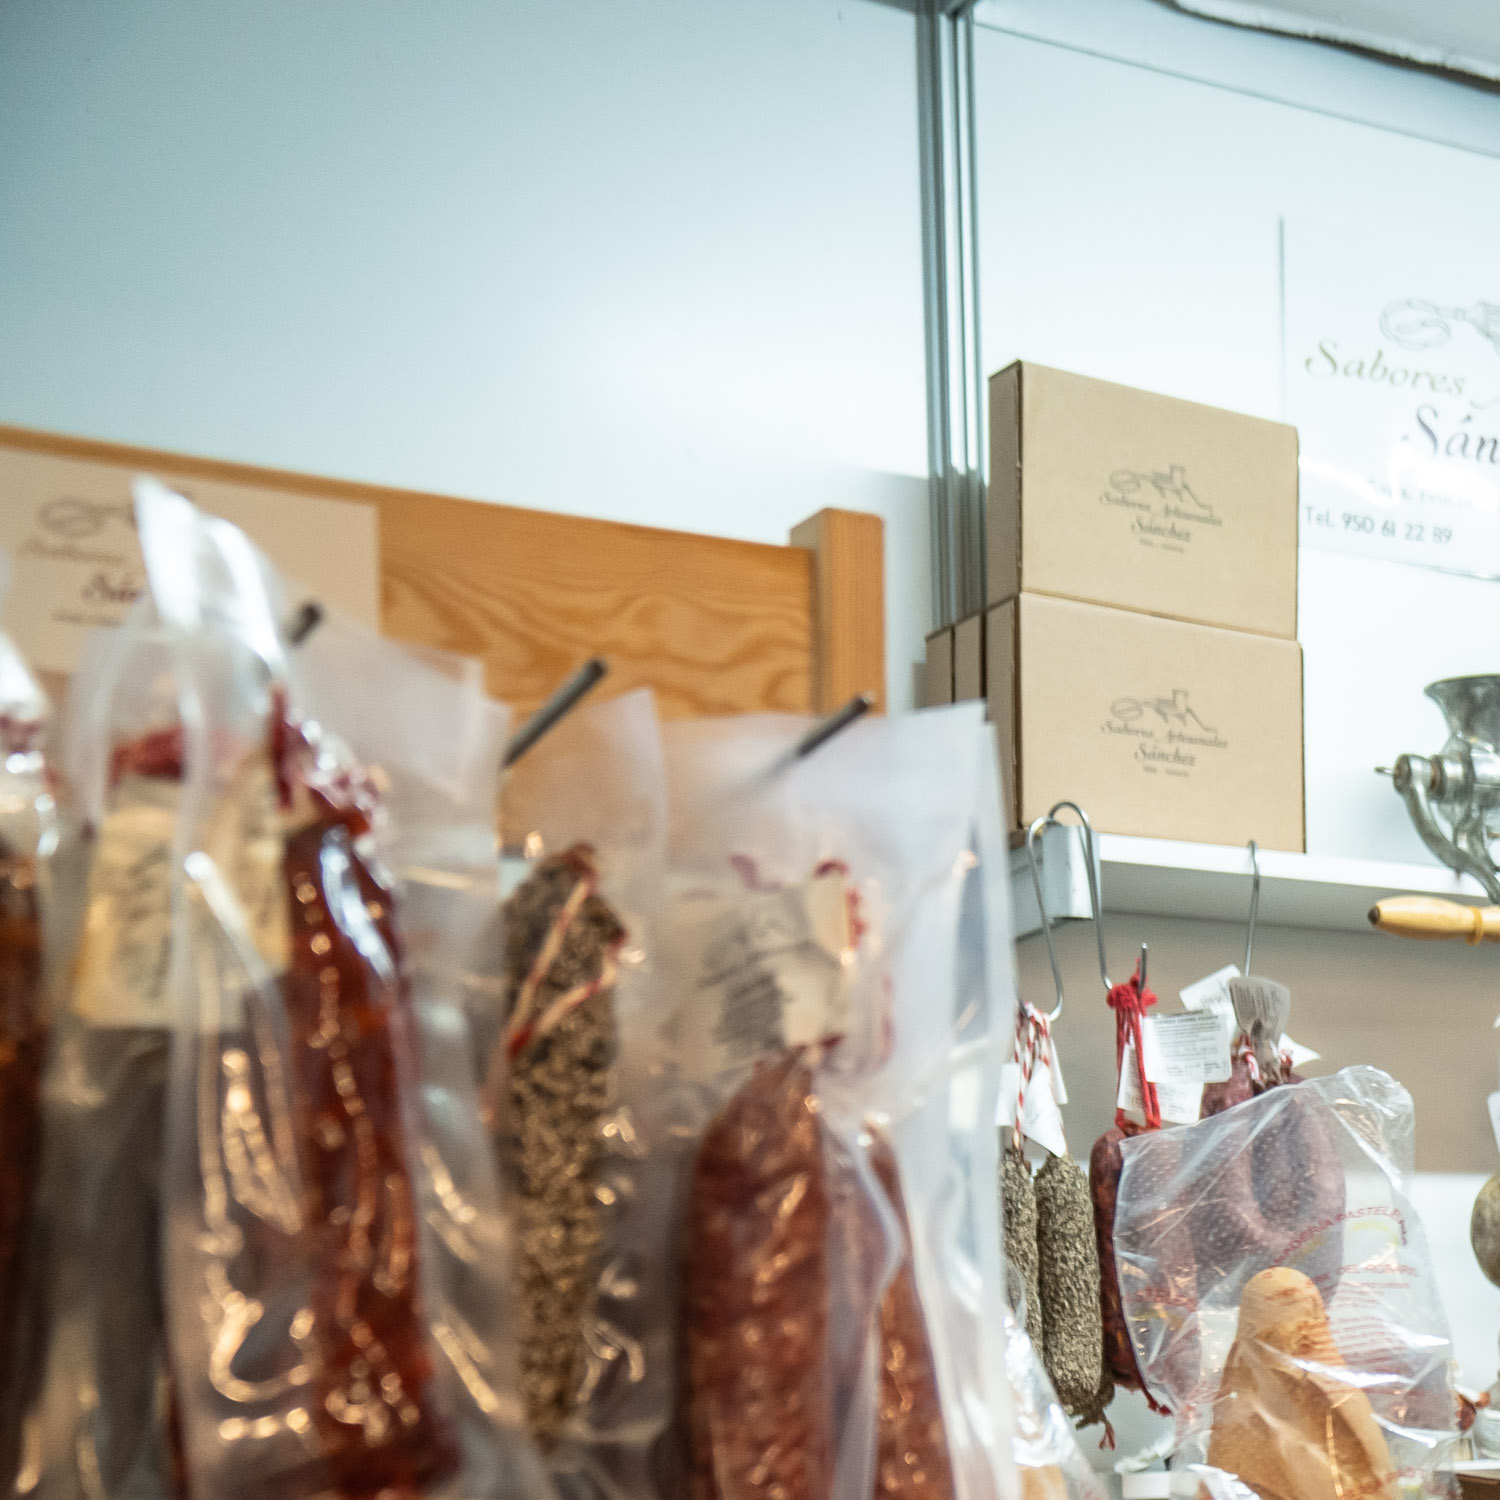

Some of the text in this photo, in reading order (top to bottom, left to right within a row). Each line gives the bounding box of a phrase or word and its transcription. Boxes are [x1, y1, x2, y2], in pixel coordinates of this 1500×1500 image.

[1304, 340, 1465, 396] Sabores
[1305, 506, 1454, 546] Tel. 950 61 22 89
